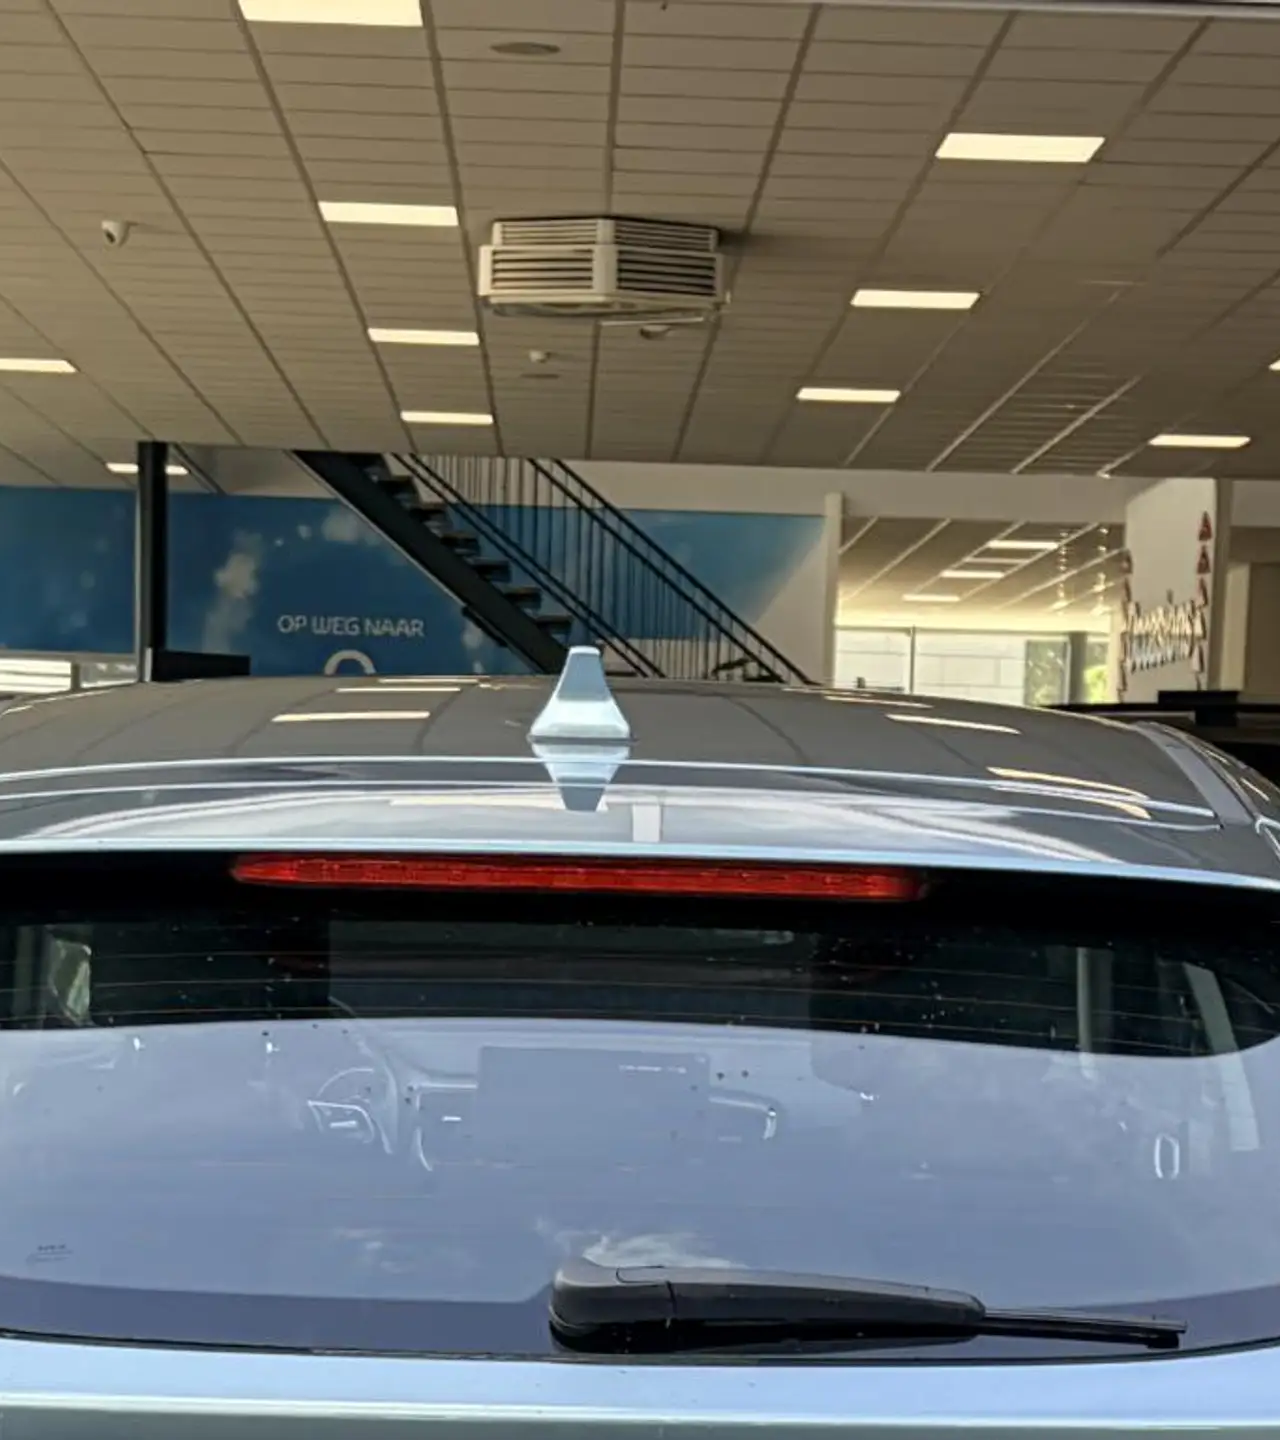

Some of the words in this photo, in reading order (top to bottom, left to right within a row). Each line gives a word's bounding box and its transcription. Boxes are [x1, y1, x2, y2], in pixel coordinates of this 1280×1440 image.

[277, 614, 308, 634] OP
[311, 616, 361, 636] WEG
[365, 618, 425, 637] NAAR
